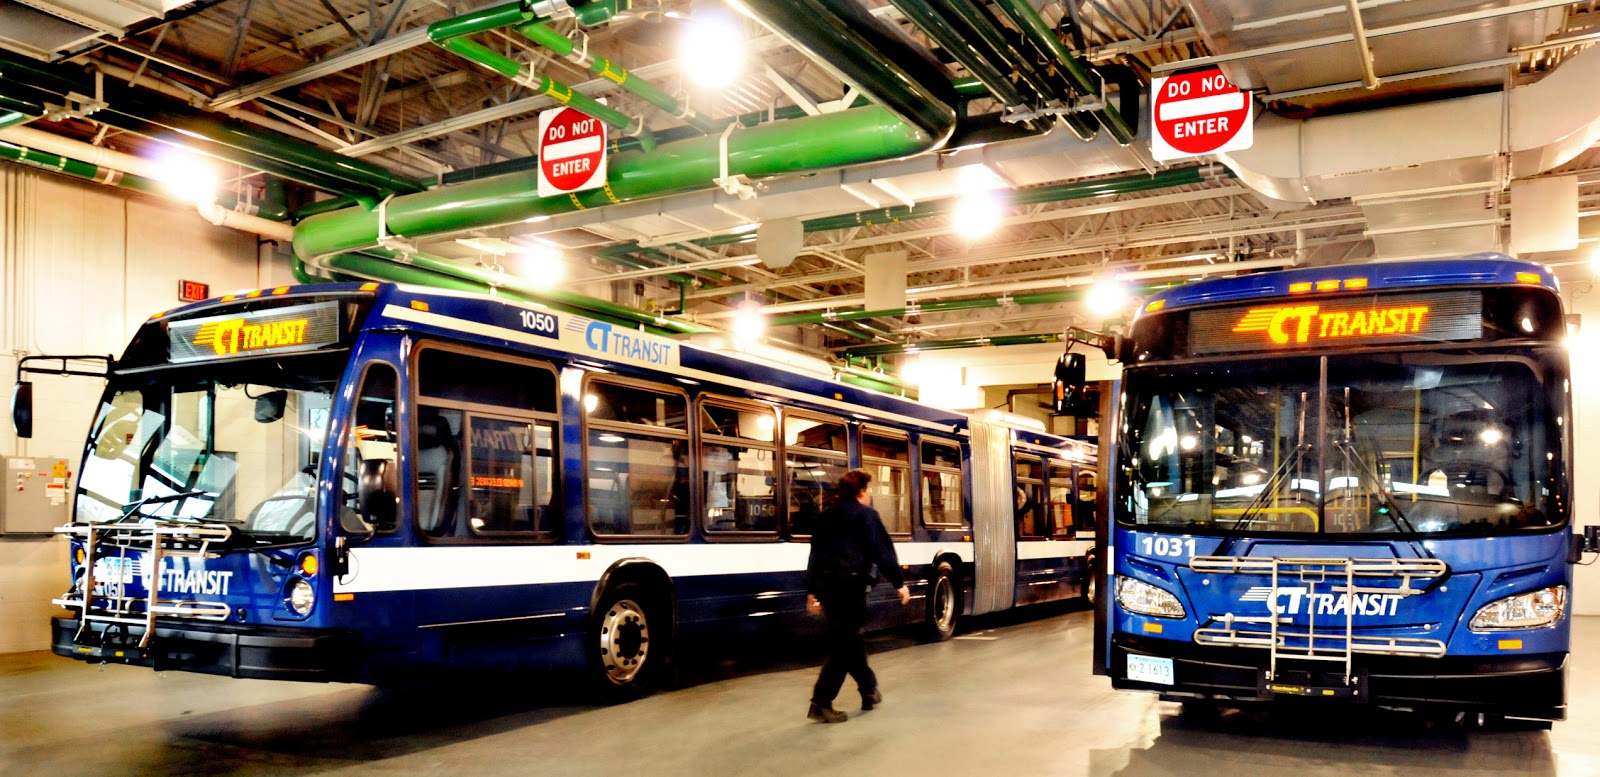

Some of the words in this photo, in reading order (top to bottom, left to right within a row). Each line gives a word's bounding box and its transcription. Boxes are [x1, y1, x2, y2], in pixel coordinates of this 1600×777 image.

[1168, 80, 1190, 98] DO
[1201, 75, 1233, 92] NO
[549, 124, 566, 140] DO
[572, 118, 595, 135] NOT
[1174, 117, 1229, 138] ENTER
[552, 157, 590, 177] ENTER
[185, 282, 206, 300] EXIT
[519, 310, 555, 333] 1050
[1267, 305, 1320, 344] CT
[1318, 307, 1429, 337] TRANSIT
[212, 318, 245, 355] CT
[243, 318, 308, 349] TRANSIT
[585, 320, 613, 353] CT
[613, 333, 671, 366] TRANSIT
[750, 504, 775, 516] 1050
[1142, 536, 1196, 558] 1031
[165, 568, 233, 596] TRANSIT
[1266, 586, 1307, 614] CT
[1305, 593, 1404, 616] TRANSIT
[1139, 662, 1170, 677] 2-1613
